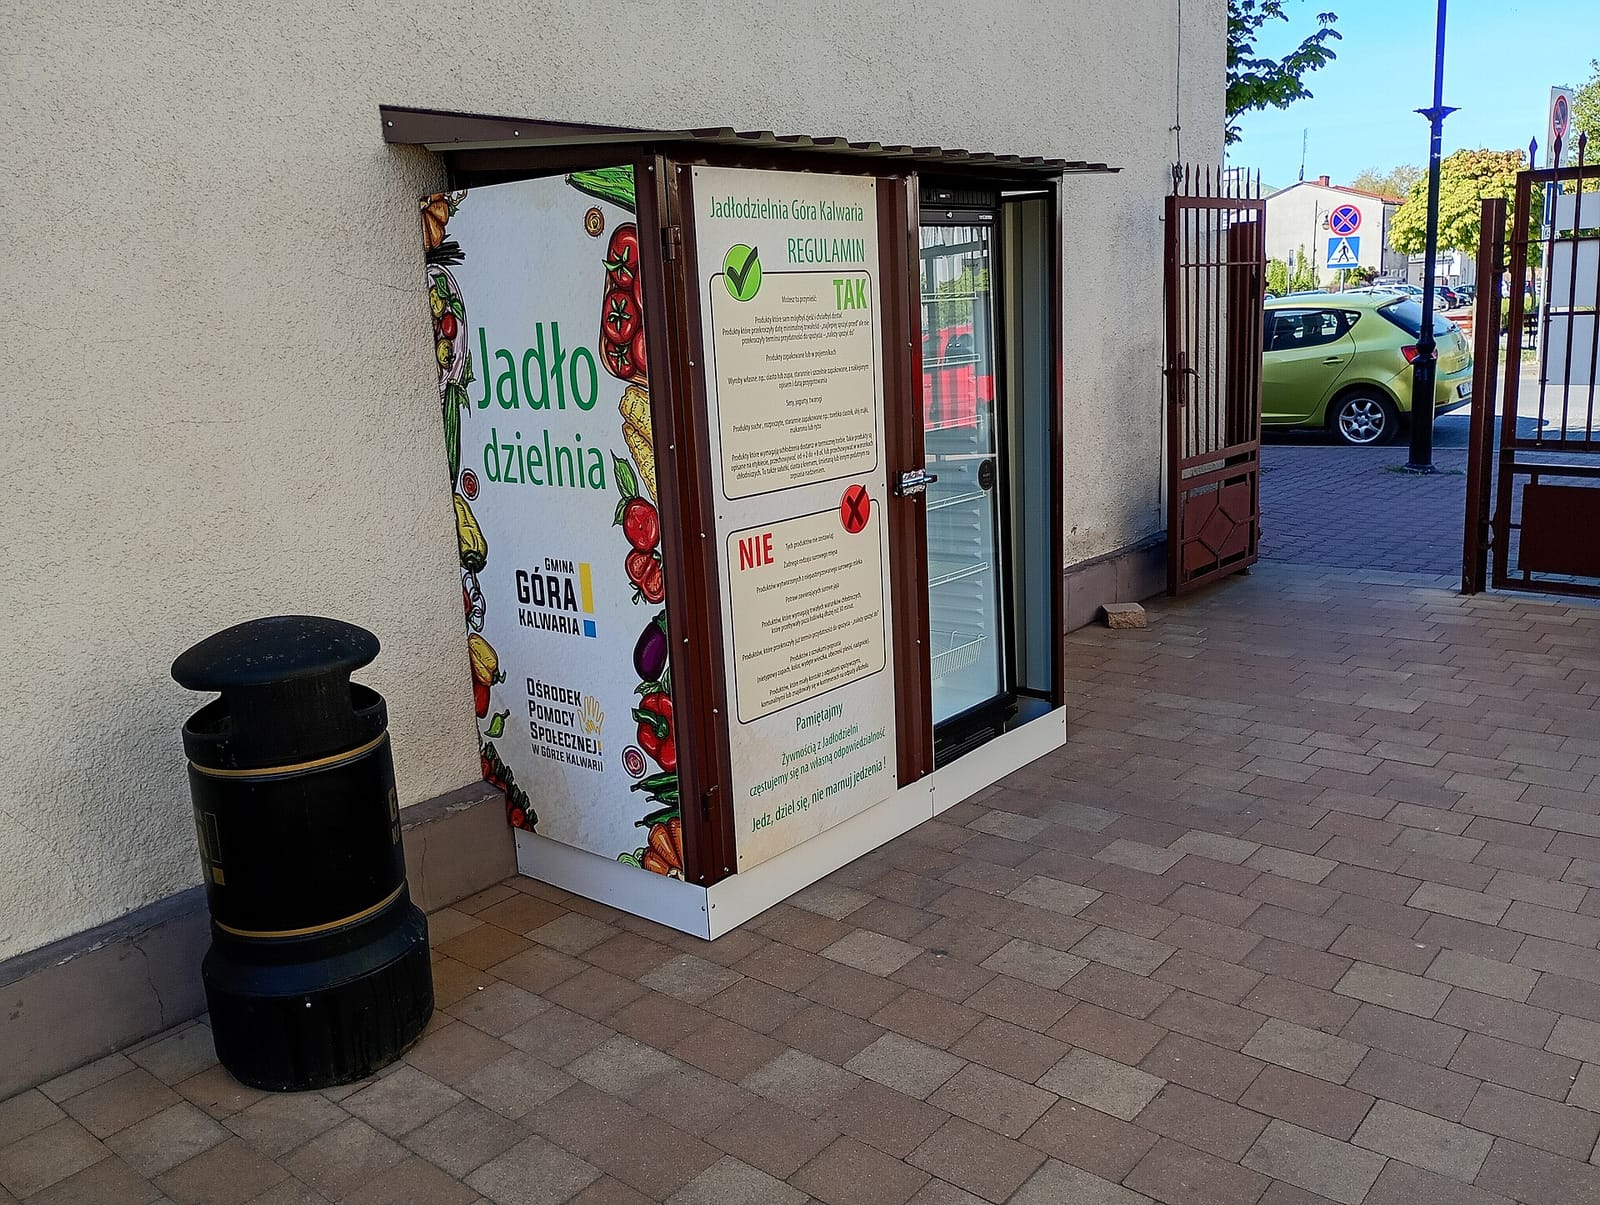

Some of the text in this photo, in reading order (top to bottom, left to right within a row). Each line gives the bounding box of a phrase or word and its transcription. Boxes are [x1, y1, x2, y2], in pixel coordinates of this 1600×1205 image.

[710, 196, 864, 222] Jadłodzielnia Góra Kalwaria
[787, 238, 866, 264] REGULAMIN
[833, 278, 868, 311] TAK
[477, 321, 599, 411] Jadło
[483, 427, 607, 490] dzielnia
[544, 557, 575, 575] GMINA
[739, 533, 774, 571] NIE
[515, 566, 579, 613] GÓRA
[518, 608, 581, 637] KALWARIA
[526, 677, 582, 708] OŚRODEK
[528, 699, 576, 728] POMOCY
[796, 703, 844, 732] Pamiętajmy
[531, 743, 604, 773] W GÓRZE KALWARII
[781, 722, 859, 766] Żywnością z Jadłodzielni
[749, 726, 887, 798] częstujemy się na własną odpowiedzialność
[751, 812, 774, 833] Jedz,
[775, 798, 795, 821] dziel
[796, 795, 810, 812] się,
[811, 787, 825, 804] nie
[825, 771, 853, 798] marnuj
[852, 760, 884, 788] jedzenia
